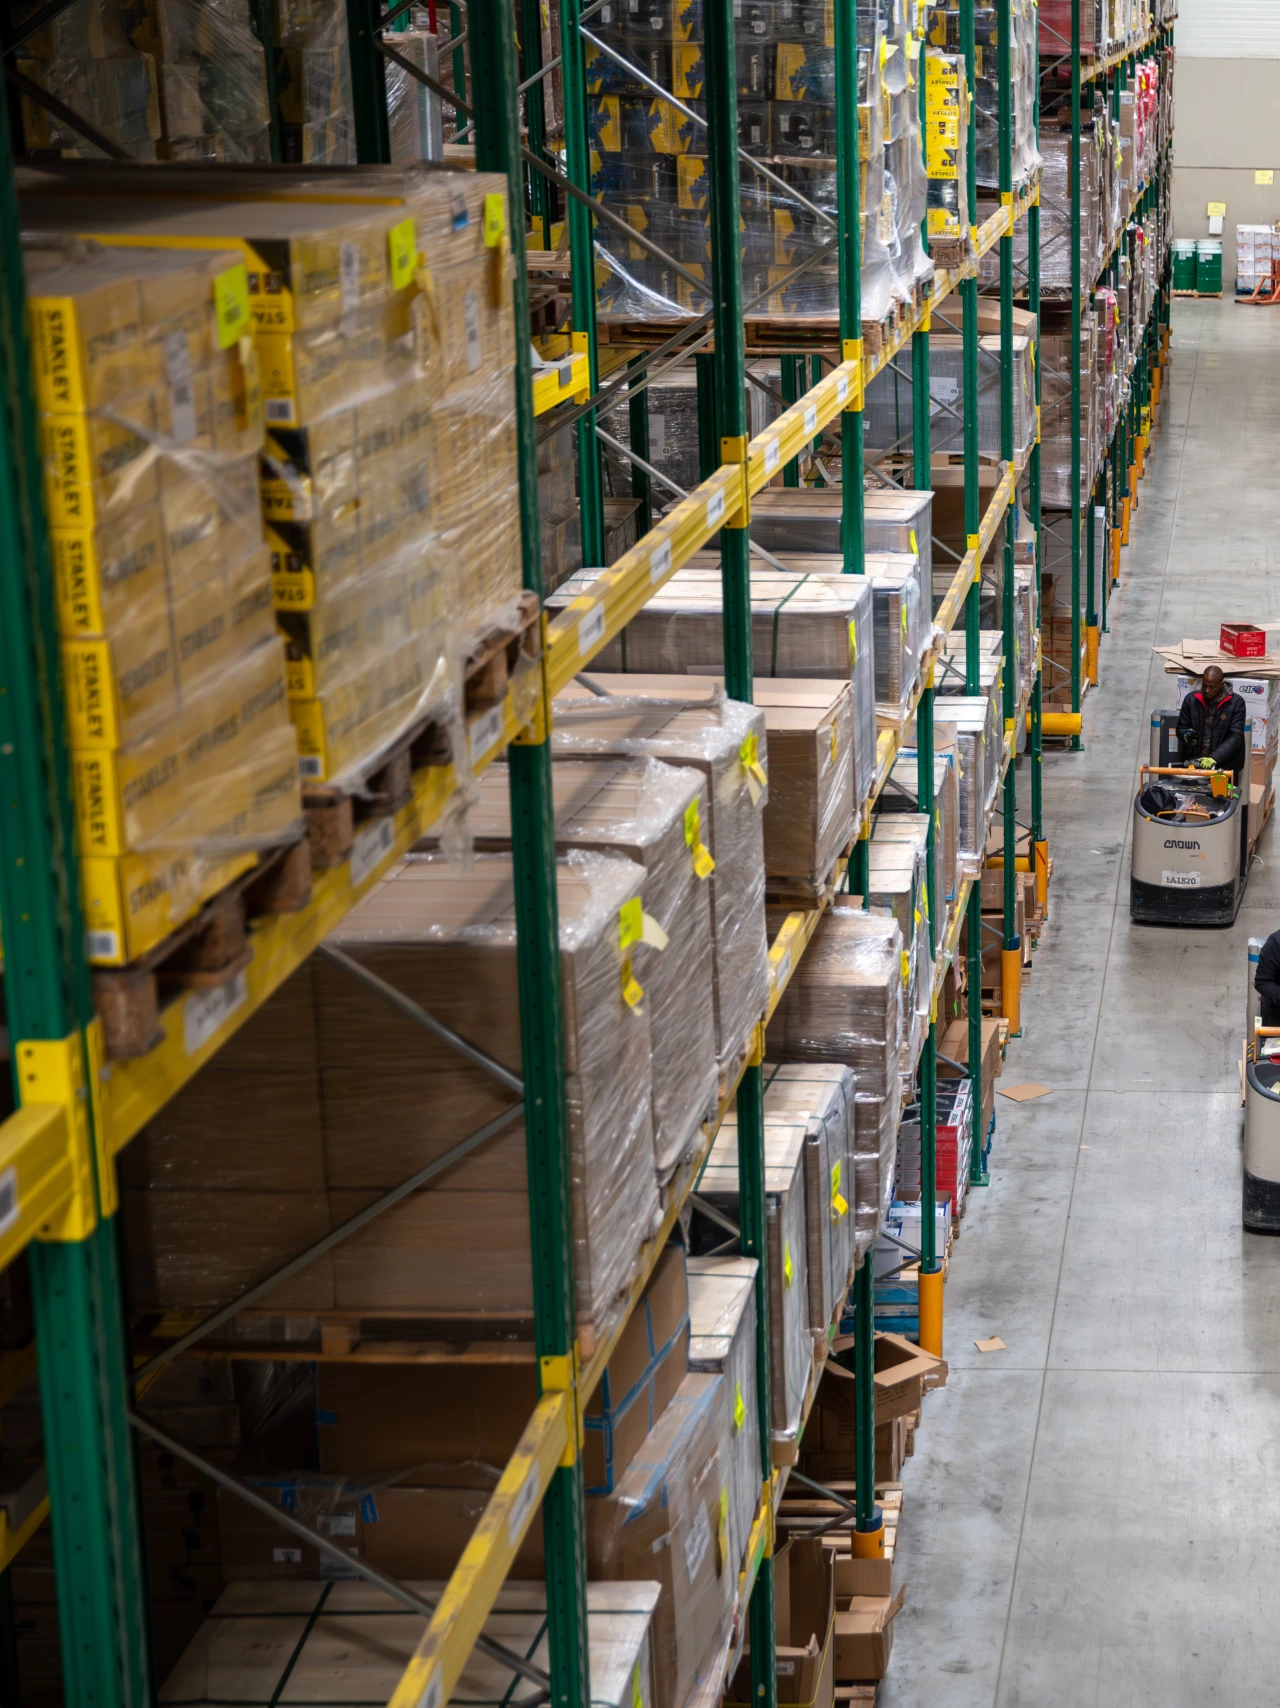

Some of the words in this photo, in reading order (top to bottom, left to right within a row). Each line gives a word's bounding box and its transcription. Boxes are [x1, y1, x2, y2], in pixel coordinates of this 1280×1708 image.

[46, 309, 70, 402] STANLEY
[56, 427, 81, 516] STANLEY
[67, 538, 91, 629] STANLEY
[81, 651, 105, 739] STANLEY
[84, 761, 107, 847] STANLEY
[1164, 840, 1200, 850] CROWN
[1166, 876, 1196, 885] LA1820
